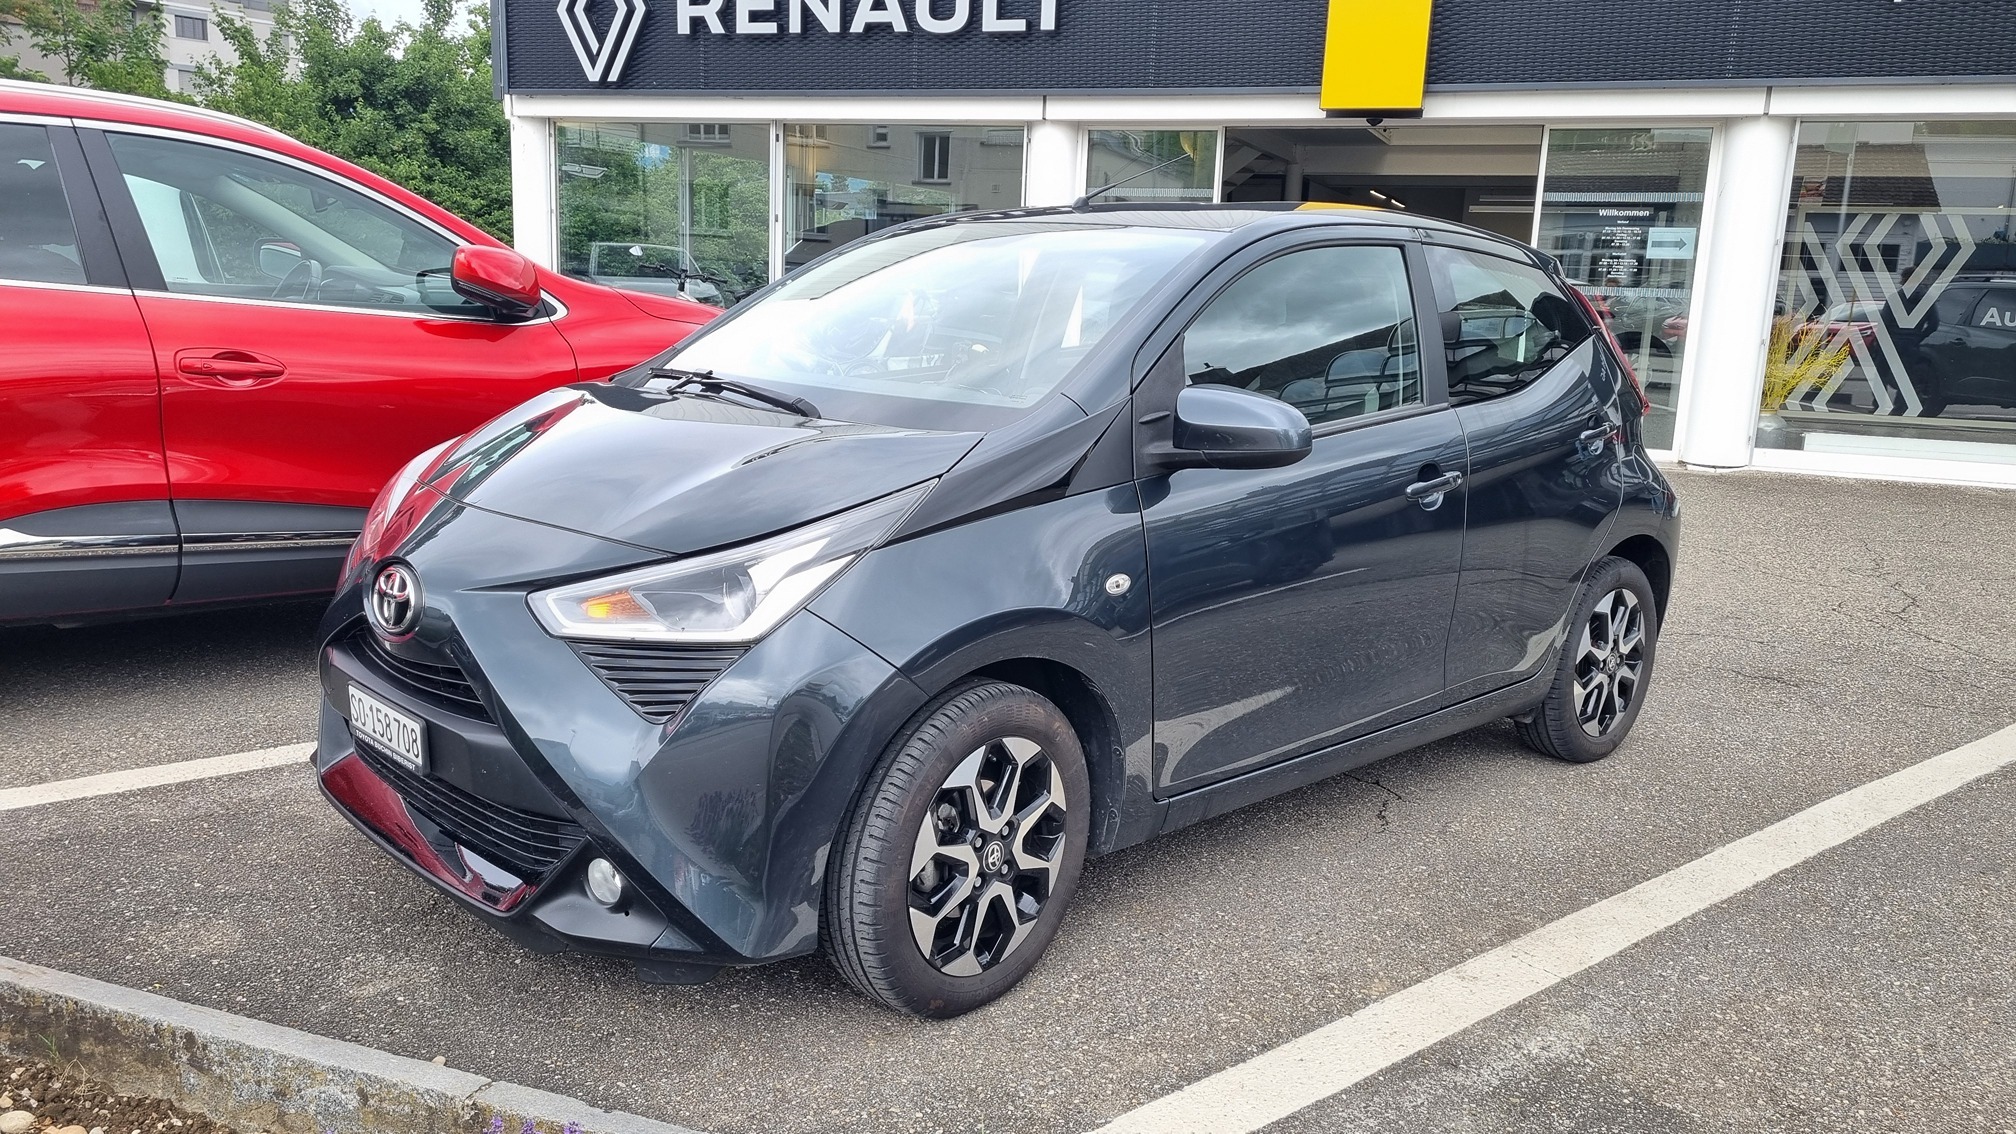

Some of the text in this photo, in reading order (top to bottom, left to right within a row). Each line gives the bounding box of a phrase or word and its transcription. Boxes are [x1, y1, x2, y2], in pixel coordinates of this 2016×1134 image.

[1599, 208, 1649, 217] Willkommen
[1980, 307, 2016, 327] Au
[355, 729, 374, 746] TOYOTA
